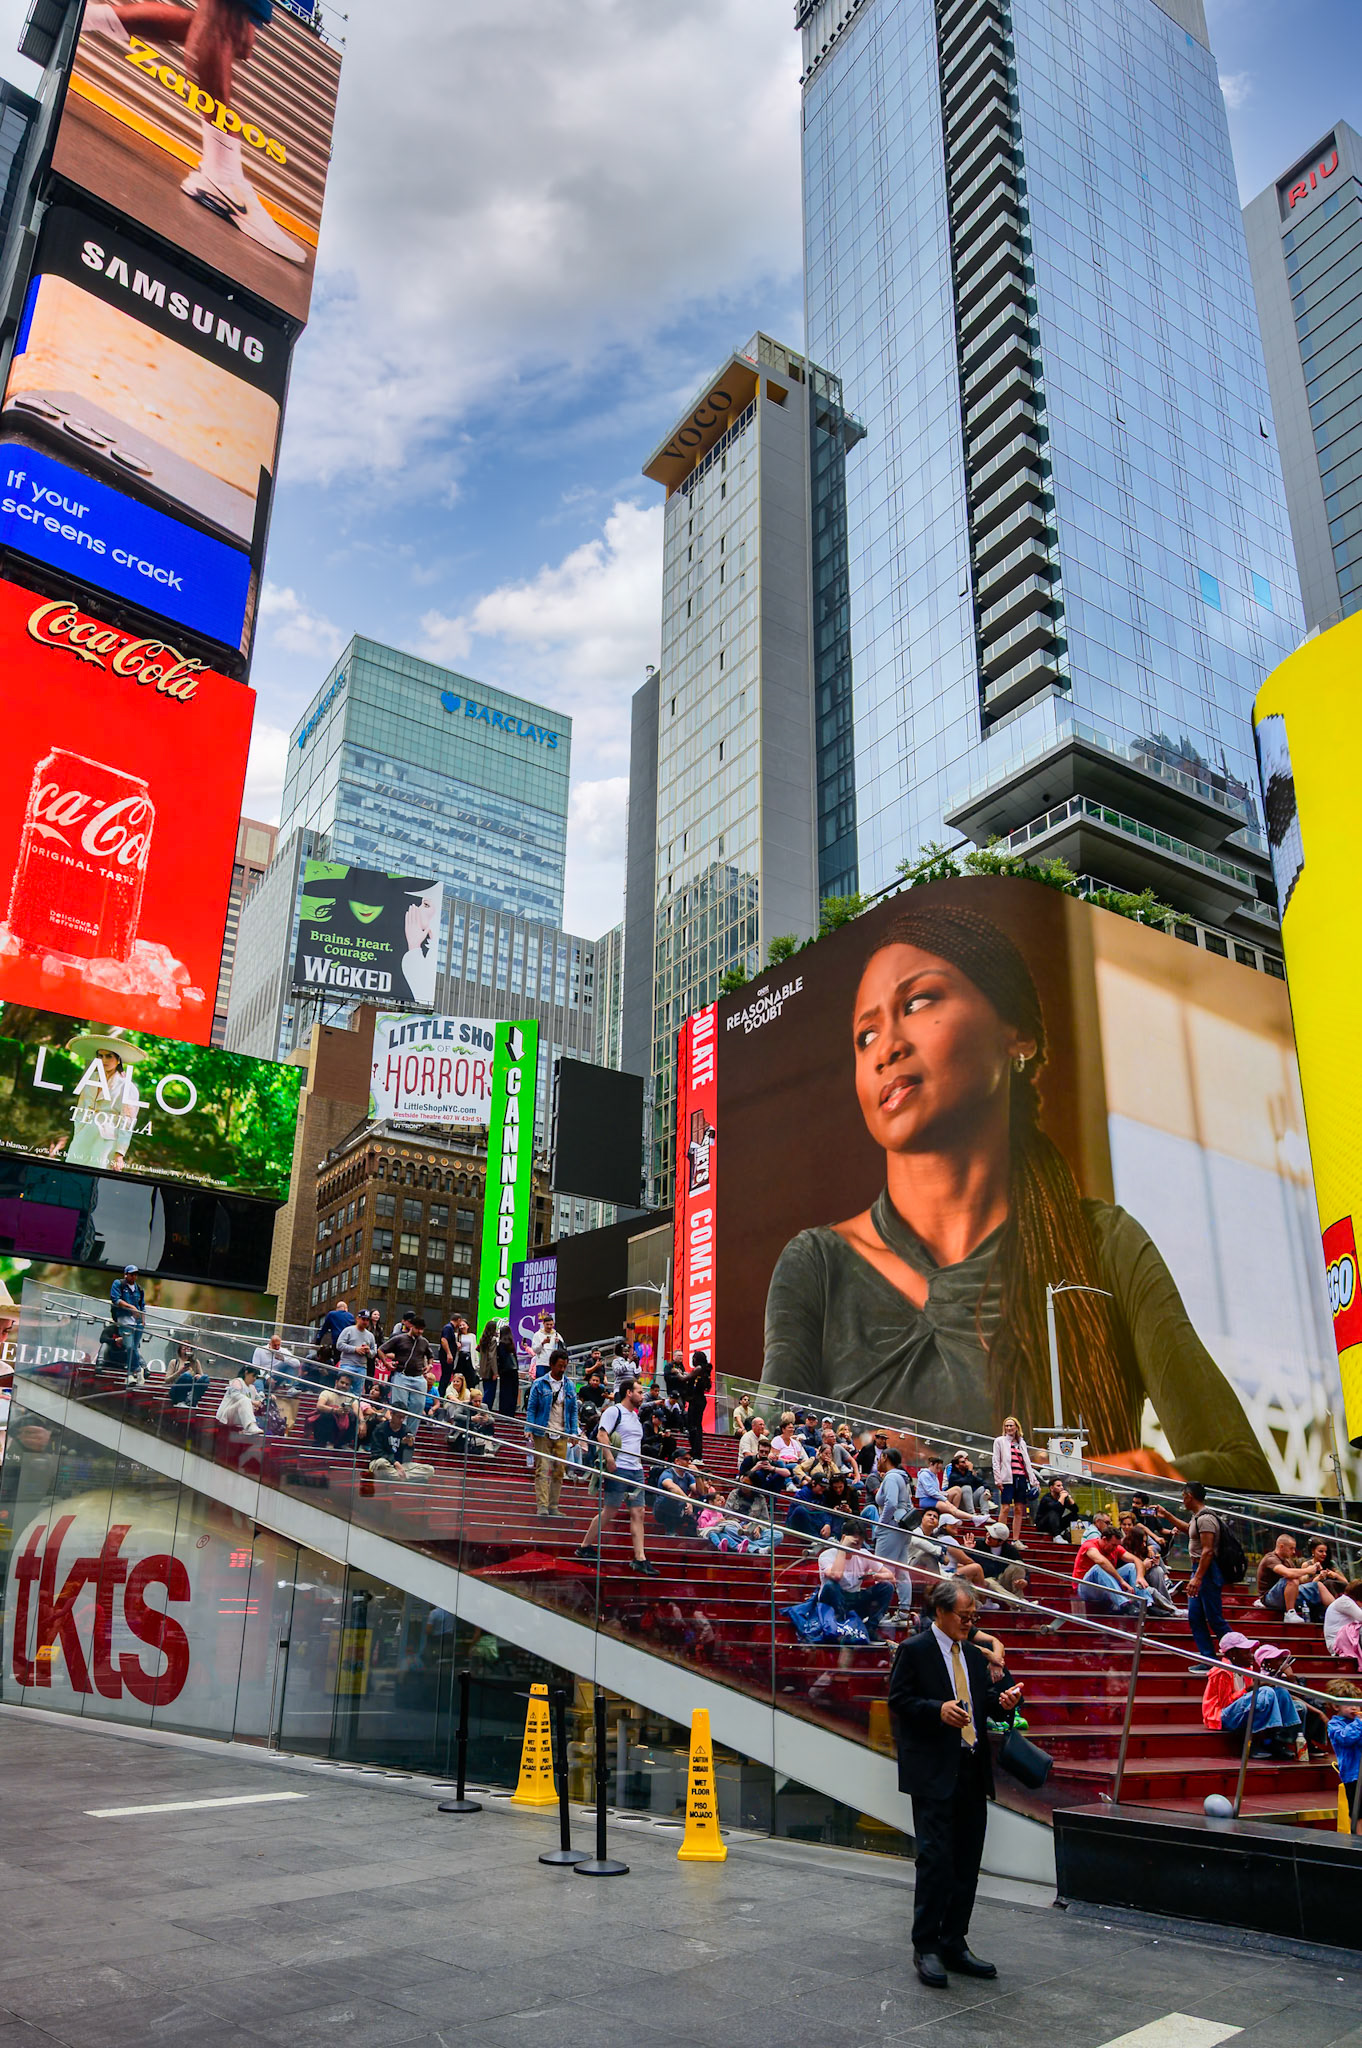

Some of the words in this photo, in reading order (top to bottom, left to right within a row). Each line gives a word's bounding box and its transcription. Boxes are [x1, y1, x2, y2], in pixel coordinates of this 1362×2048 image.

[125, 35, 287, 165] Zappos
[1288, 150, 1339, 208] RIU
[80, 240, 265, 363] SAMSUNG
[6, 469, 27, 490] If
[31, 481, 90, 519] your
[0, 497, 107, 555] screens
[111, 547, 184, 592] crack
[27, 599, 211, 700] Coca-Cola
[465, 699, 559, 750] BARCLAYS
[31, 845, 94, 873] ORIGINAL
[99, 867, 135, 886] TASTE
[49, 909, 92, 928] Delicious
[49, 915, 98, 937] Refreshing
[310, 930, 354, 946] Brains.
[356, 937, 394, 952] Heart.
[324, 944, 378, 962] Courage.
[726, 975, 804, 1032] REASONABLE
[744, 1001, 784, 1034] DOUBT
[388, 1020, 455, 1050] LITTLE
[459, 1023, 494, 1052] SHO
[437, 1044, 451, 1053] OF
[33, 1046, 198, 1116] LALO
[69, 1105, 154, 1137] TEQUILA
[393, 1111, 419, 1119] Westside
[442, 1113, 453, 1121] 407
[403, 1102, 477, 1114] LittleShopNYC.com
[495, 1067, 522, 1309] CANNABIS
[690, 1207, 713, 1287] COME
[688, 1290, 712, 1370] INSID
[12, 1515, 191, 1706] tkts
[691, 1788, 710, 1796] FLOOR
[694, 1802, 708, 1810] PISO
[689, 1811, 713, 1819] MOJADO
